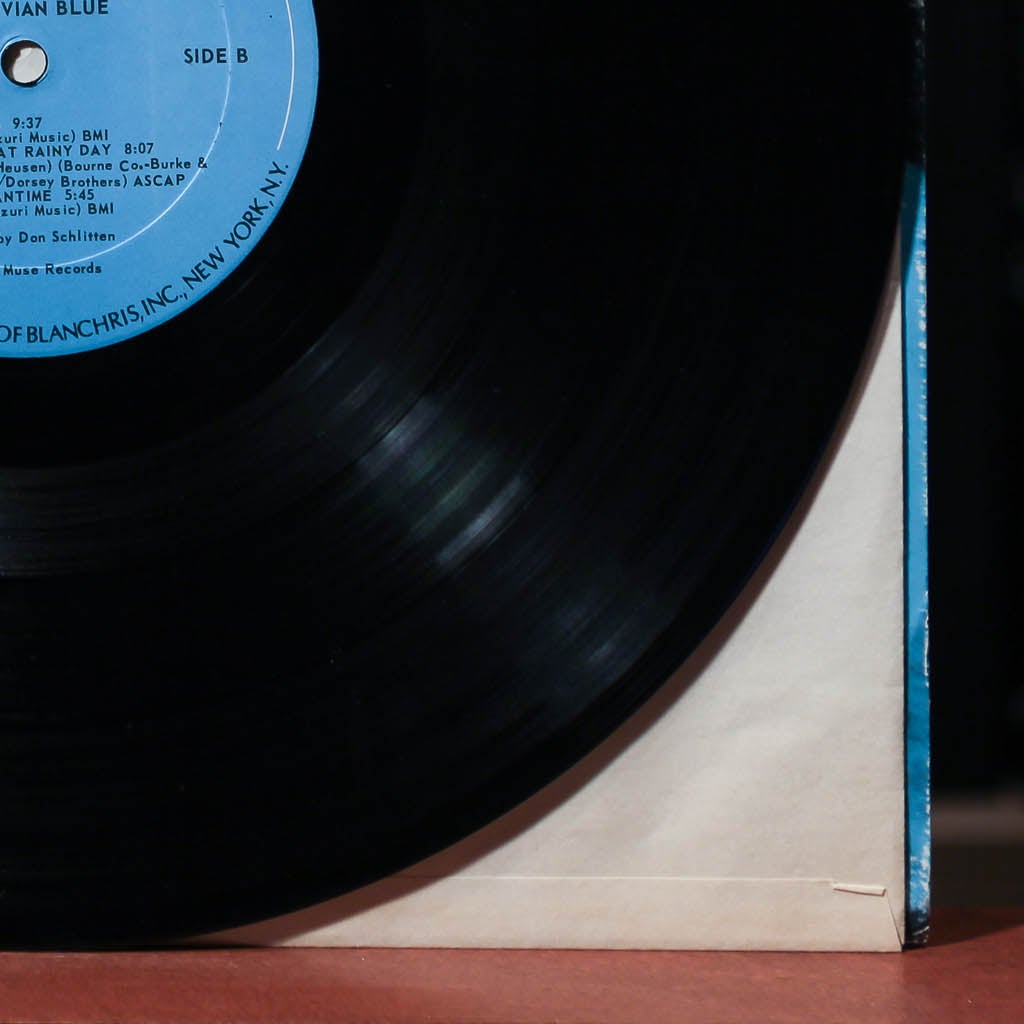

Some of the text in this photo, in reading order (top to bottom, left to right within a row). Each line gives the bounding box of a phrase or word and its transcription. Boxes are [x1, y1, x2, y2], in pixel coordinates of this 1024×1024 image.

[56, 0, 109, 16] BLUE
[183, 47, 249, 65] SIDE B
[12, 116, 43, 130] 9:37
[29, 129, 76, 144] Music)
[82, 128, 109, 142] BMI
[25, 144, 73, 158] RAINY
[80, 143, 112, 156] DAY
[124, 142, 154, 155] 8:07
[58, 159, 113, 174] (Bourne
[197, 156, 208, 169] &
[61, 174, 128, 188] Brothers)
[133, 173, 186, 187] ASCAP
[65, 188, 95, 201] 5:45
[34, 202, 81, 218] Music)
[88, 202, 114, 215] BMI
[182, 245, 225, 291] NEW
[259, 161, 289, 198] N.Y.
[18, 231, 46, 244] Don
[52, 229, 116, 243] Schlitten
[3, 262, 39, 276] Muse
[45, 262, 102, 275] Records
